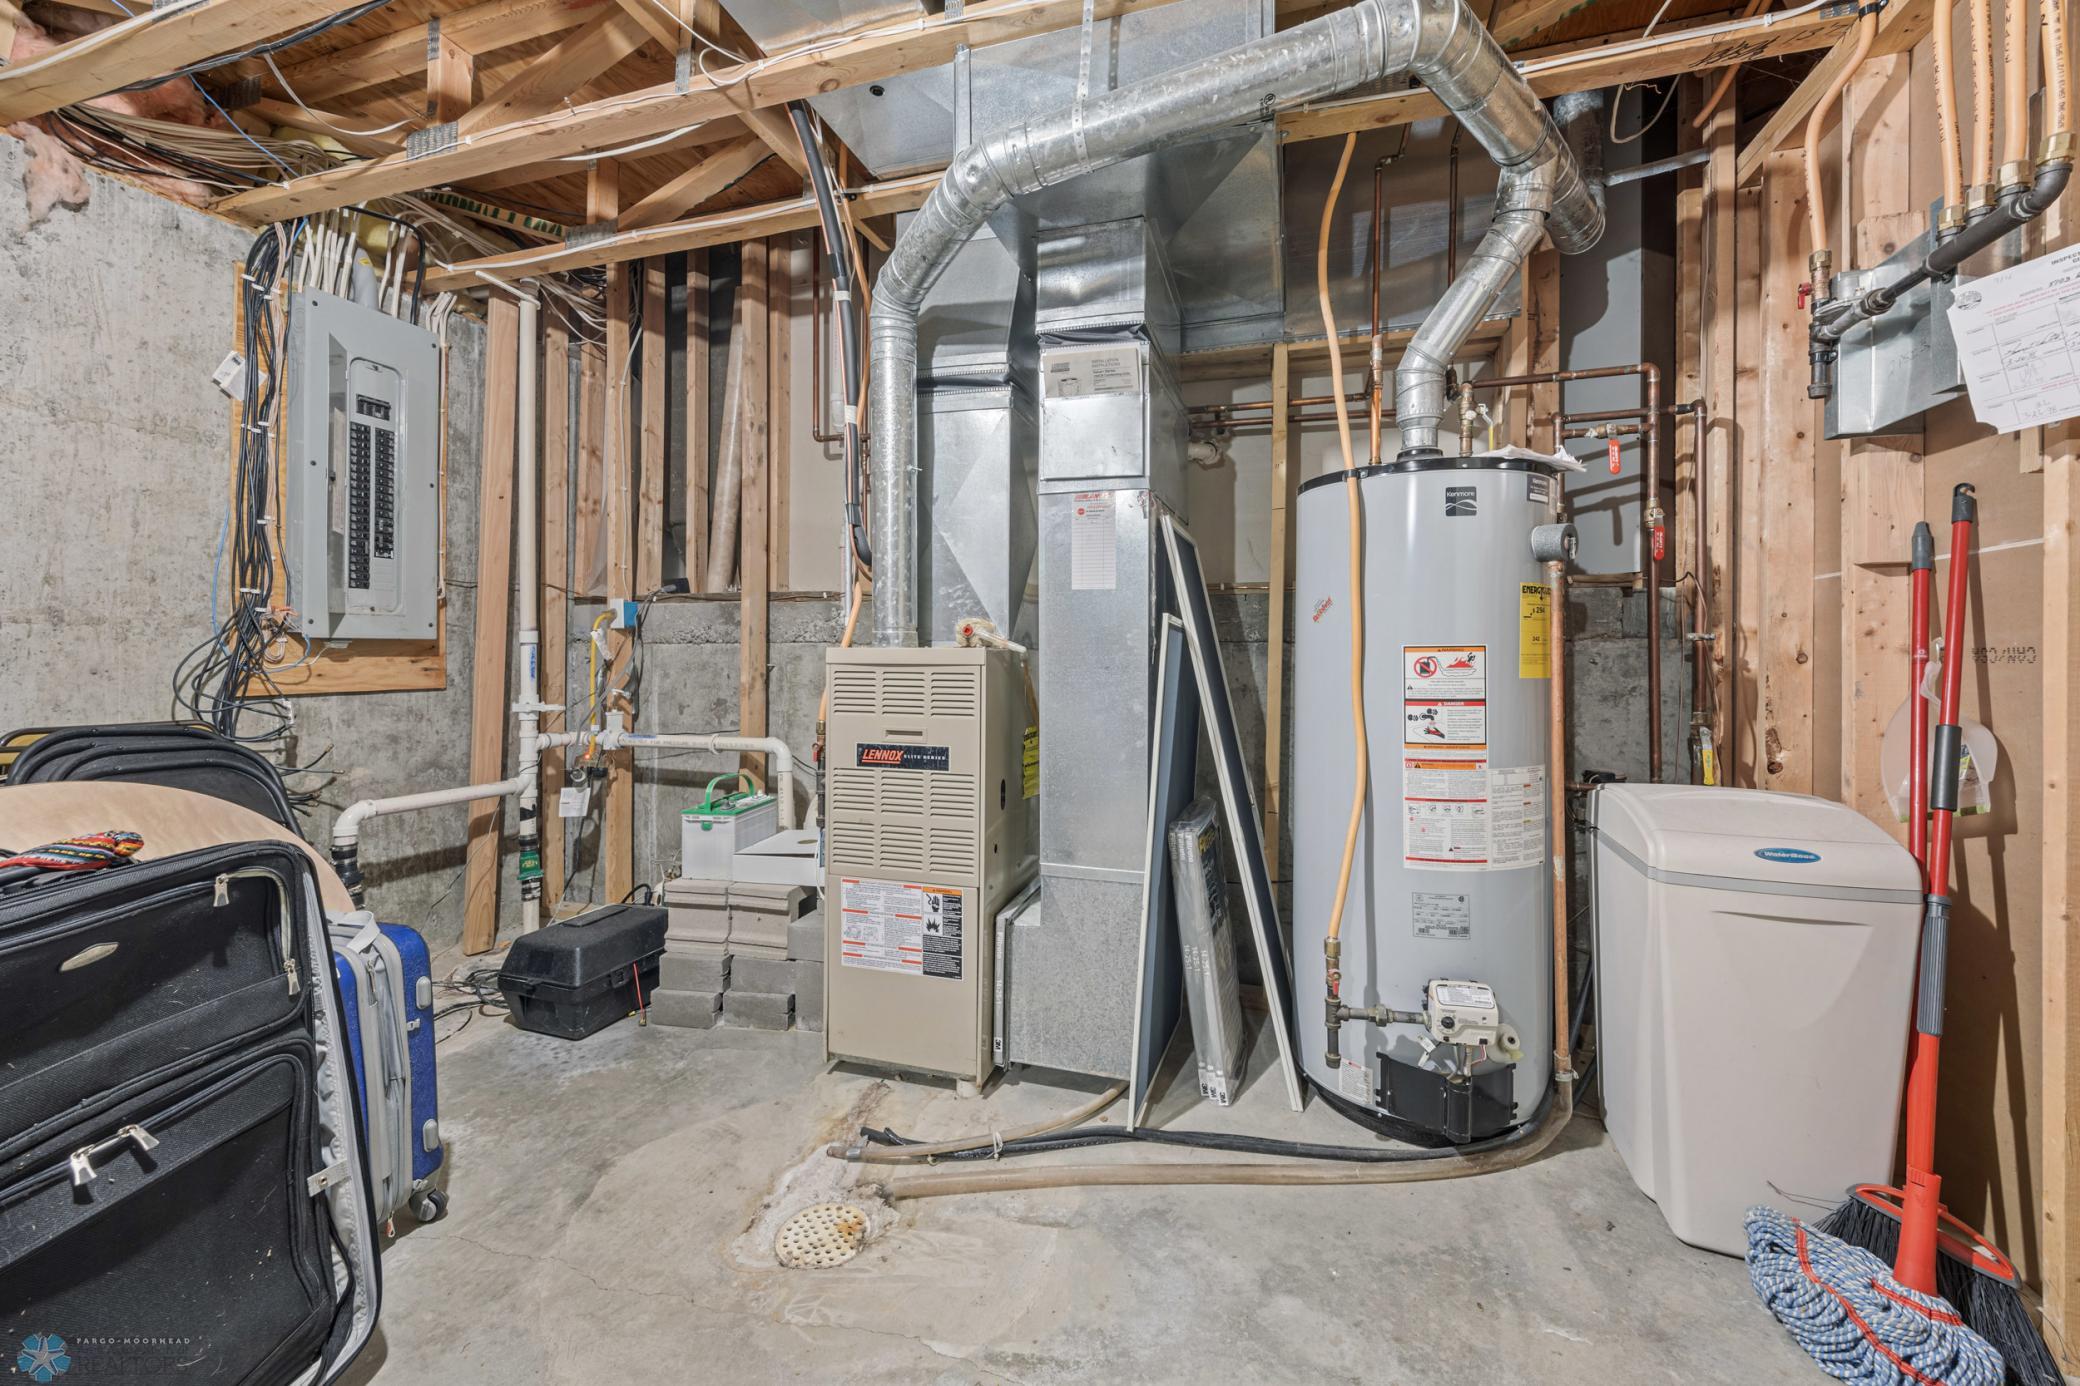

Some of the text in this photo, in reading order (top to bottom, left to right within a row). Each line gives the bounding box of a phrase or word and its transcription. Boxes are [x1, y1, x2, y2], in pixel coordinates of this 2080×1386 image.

[862, 748, 905, 761] LENNOX
[995, 1039, 1001, 1051] 3M
[1201, 1082, 1209, 1095] 3M
[1219, 1091, 1227, 1104] 3M
